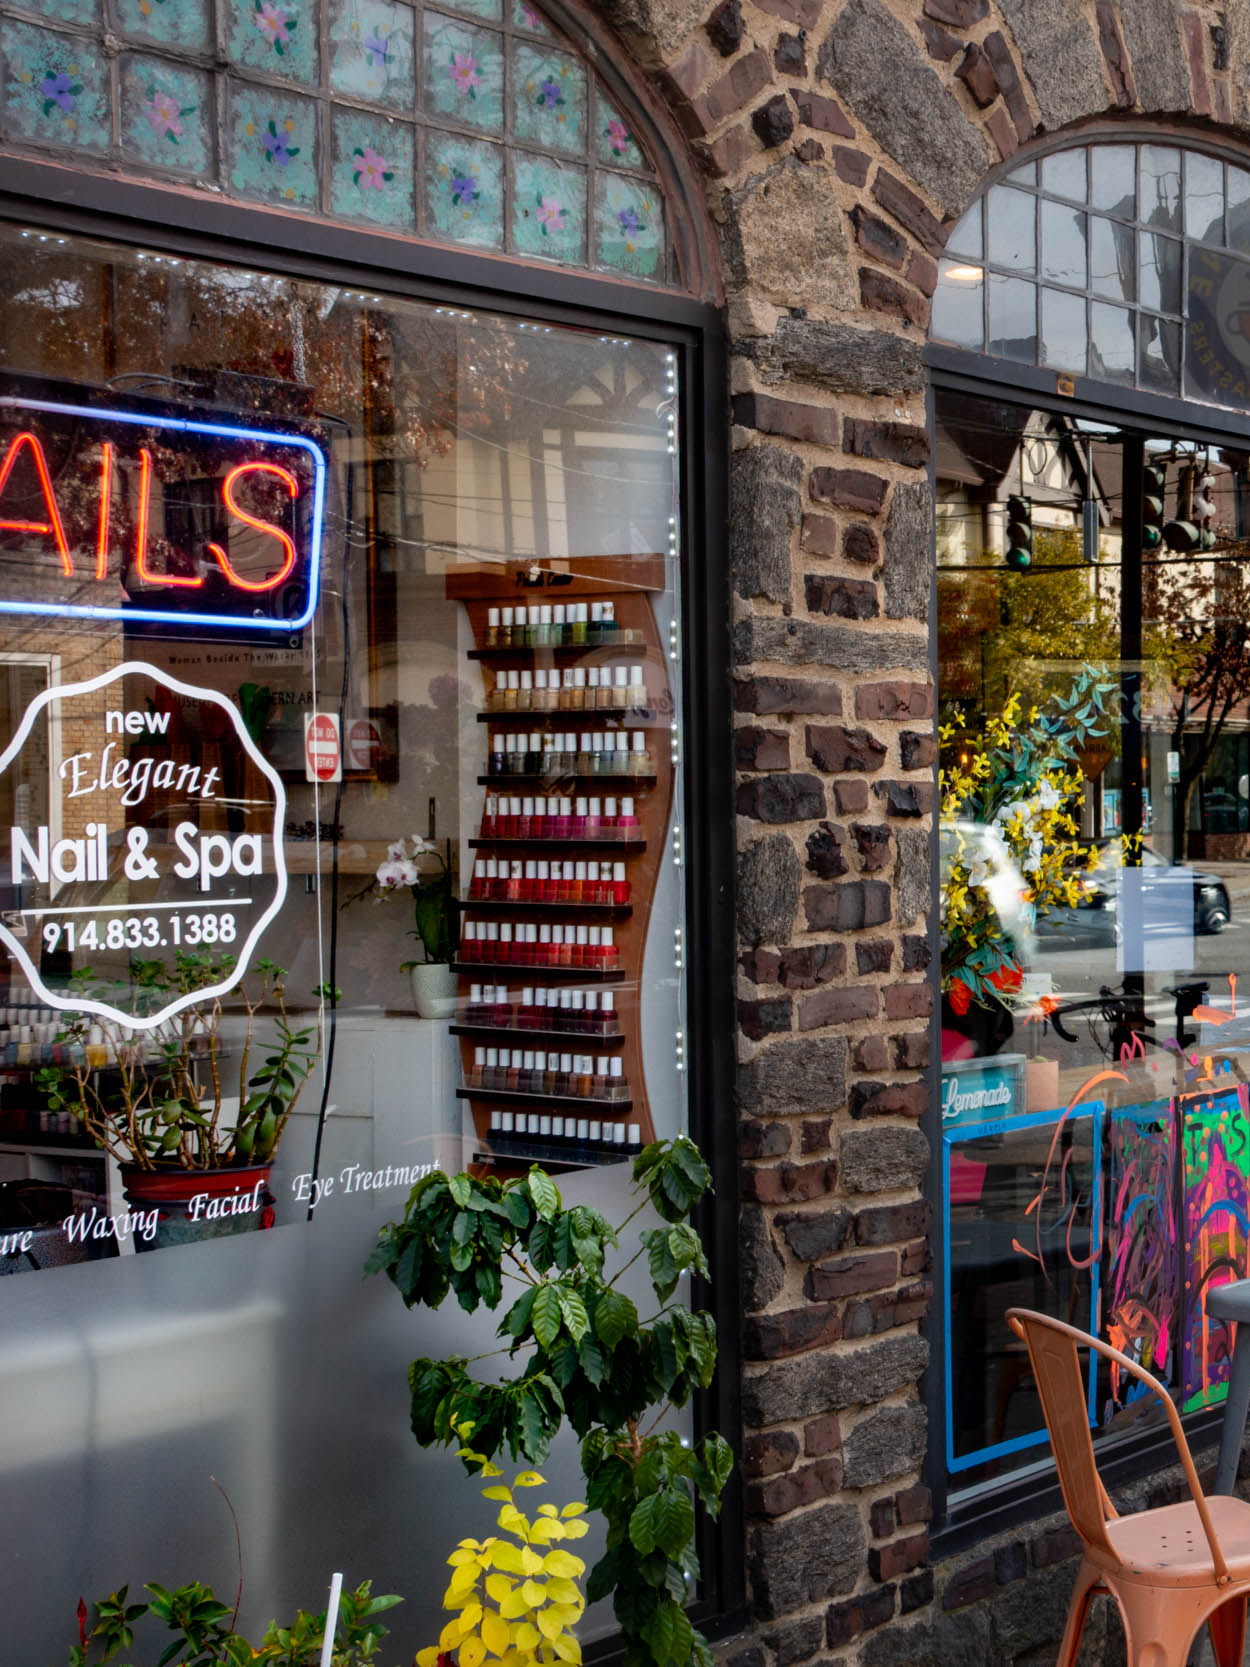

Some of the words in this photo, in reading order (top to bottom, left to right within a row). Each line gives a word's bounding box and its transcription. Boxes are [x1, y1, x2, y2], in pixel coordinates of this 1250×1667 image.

[0, 432, 299, 592] AILS
[105, 710, 171, 735] new
[58, 741, 222, 806] Elegant
[11, 823, 108, 885] Nail
[124, 826, 160, 881] &
[174, 821, 263, 891] Spa
[43, 913, 236, 953] 914.833.1388
[942, 1078, 1012, 1120] Lemonade
[63, 1206, 160, 1242] Waxing
[188, 1179, 265, 1223] Facial
[292, 1172, 334, 1209] Eye
[339, 1159, 441, 1194] Treatment
